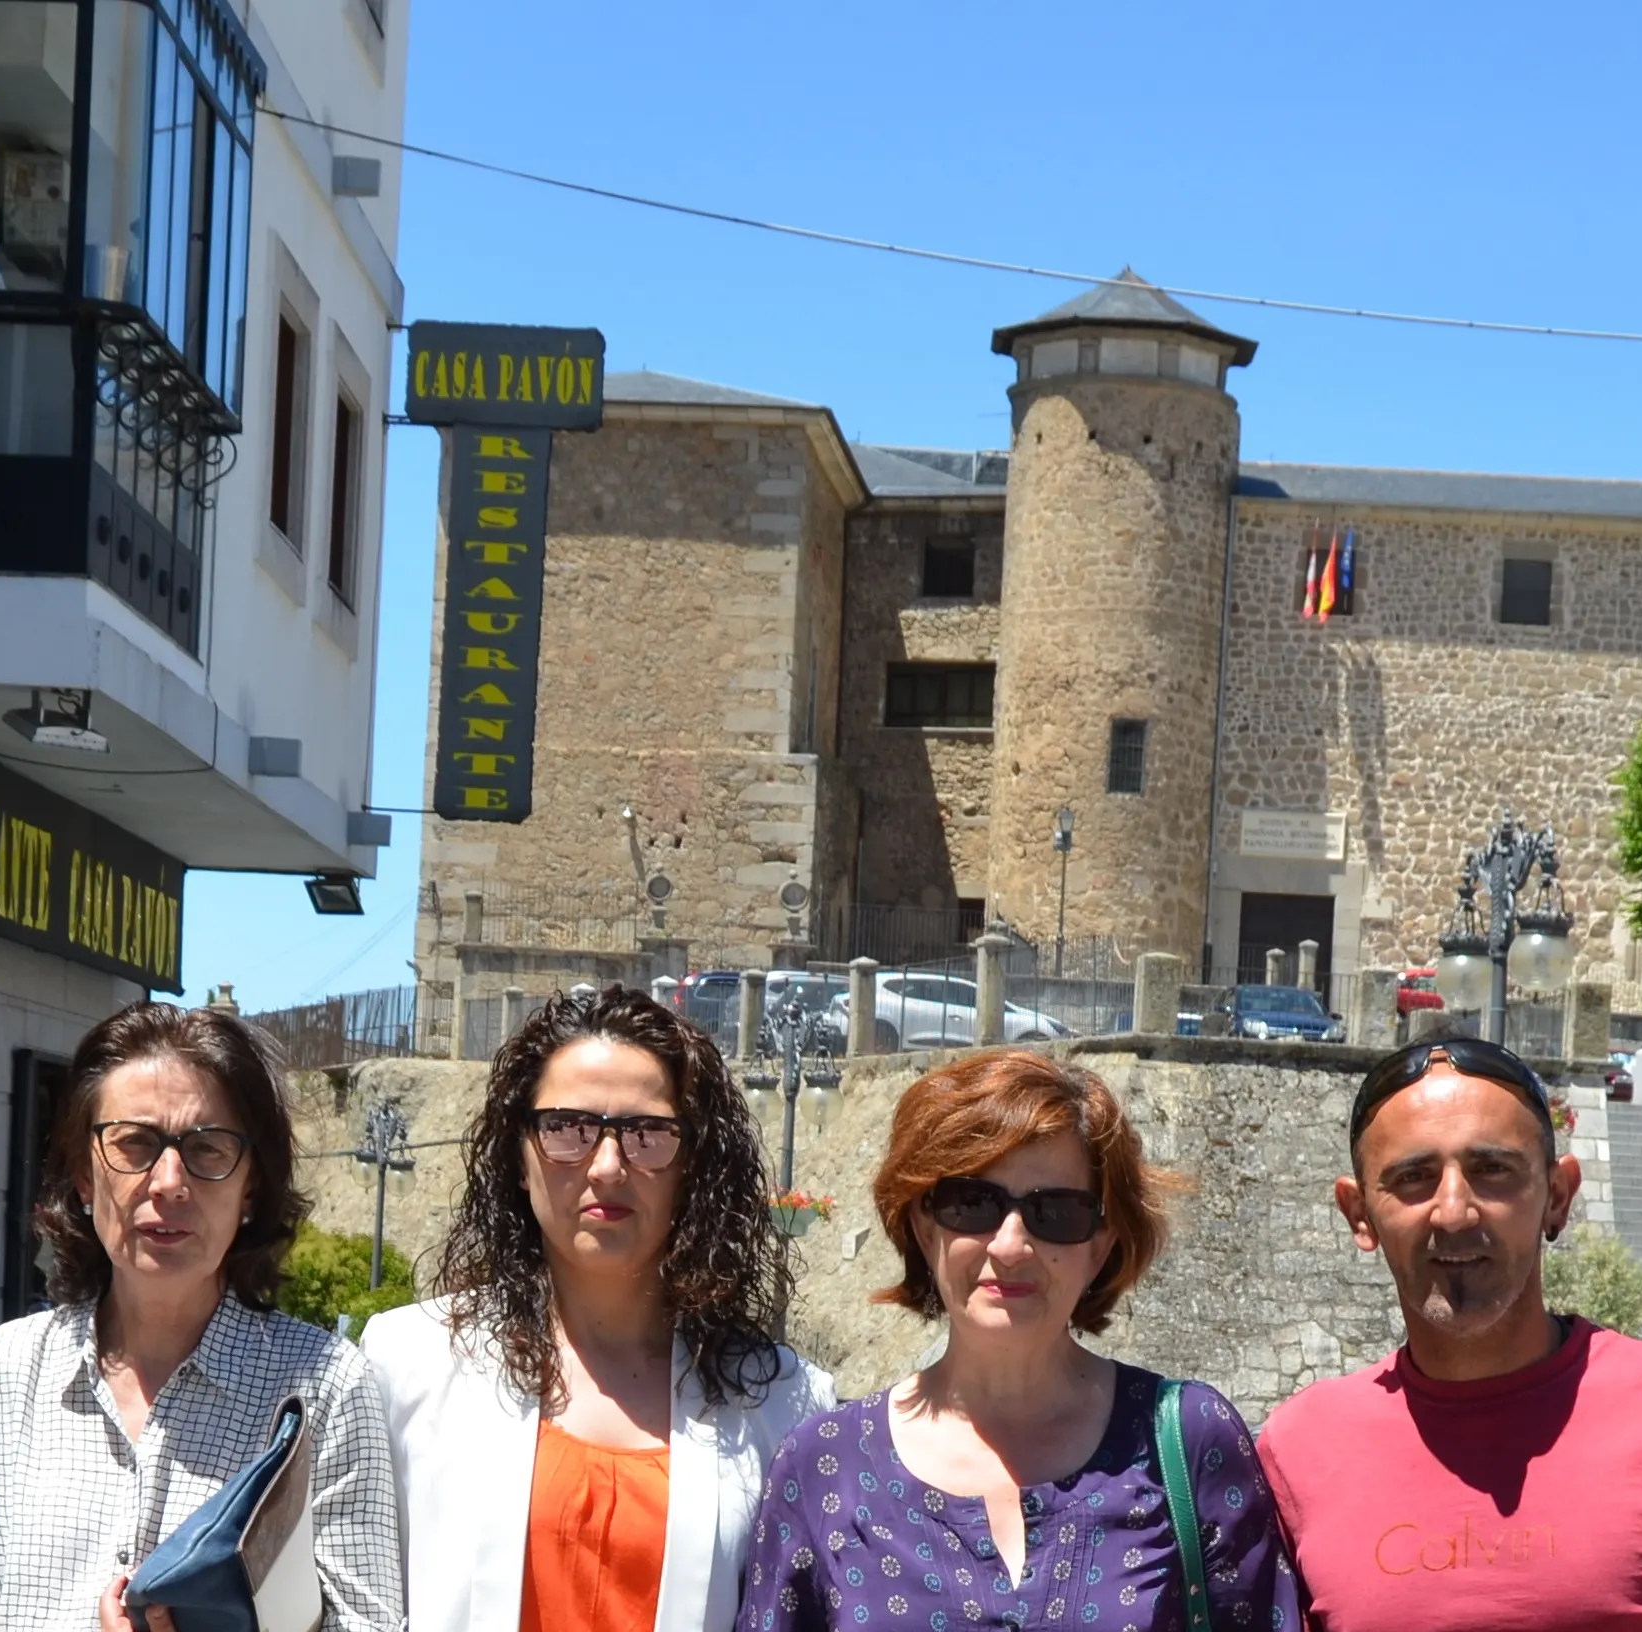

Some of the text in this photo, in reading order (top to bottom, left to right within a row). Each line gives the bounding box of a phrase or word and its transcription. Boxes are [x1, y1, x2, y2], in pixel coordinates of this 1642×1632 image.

[414, 342, 595, 405] CASA PAVÓN
[453, 434, 535, 811] RESTAURANTE
[68, 849, 115, 957] CASA
[119, 864, 178, 979] PAVÓN
[1375, 1515, 1556, 1576] Calvin
